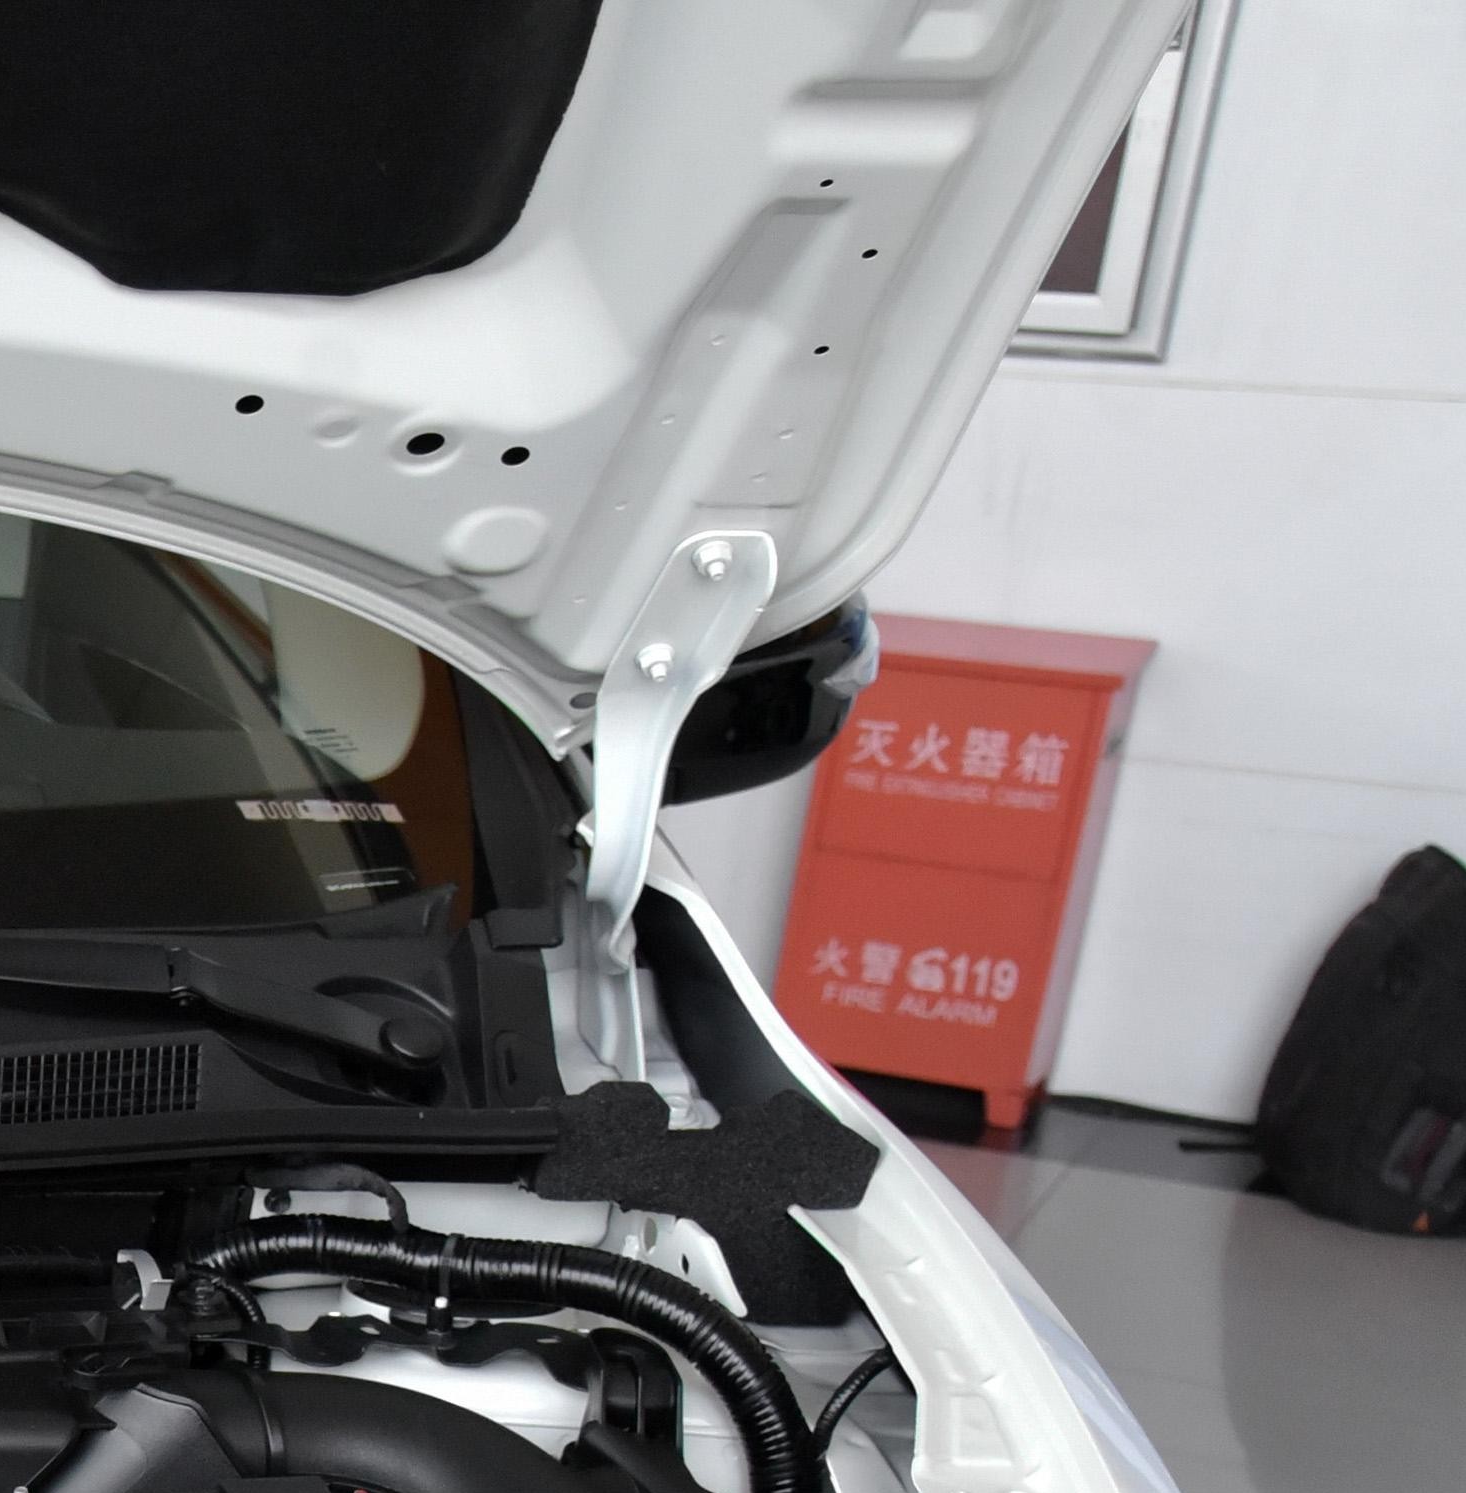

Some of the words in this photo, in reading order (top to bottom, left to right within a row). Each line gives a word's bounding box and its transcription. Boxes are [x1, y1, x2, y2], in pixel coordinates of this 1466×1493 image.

[849, 719, 1069, 786] 灭火器箱
[950, 953, 1019, 1002] 119
[822, 981, 886, 1014] FIRE
[896, 992, 1000, 1027] ALARM
